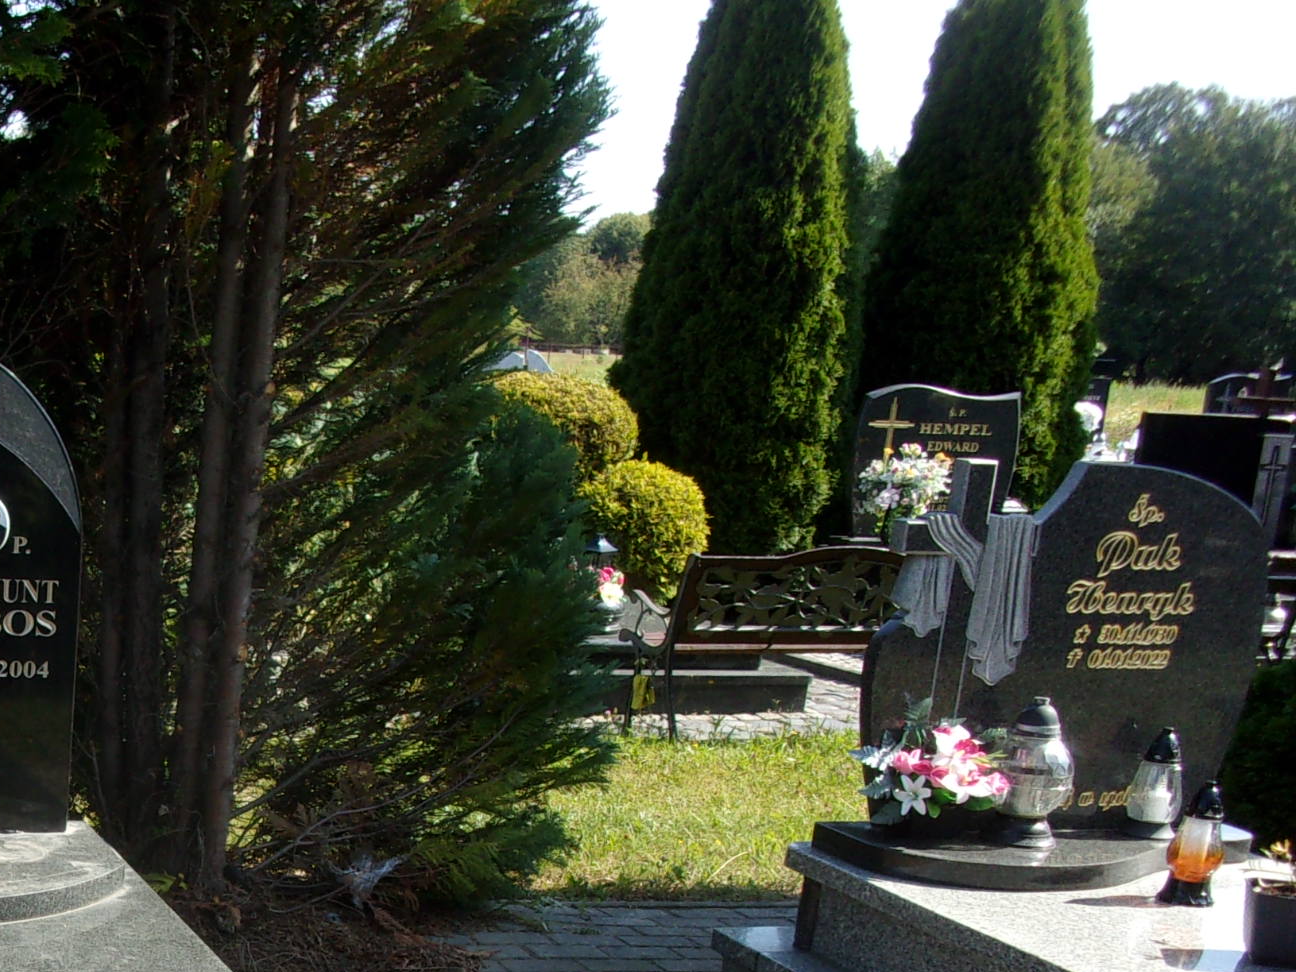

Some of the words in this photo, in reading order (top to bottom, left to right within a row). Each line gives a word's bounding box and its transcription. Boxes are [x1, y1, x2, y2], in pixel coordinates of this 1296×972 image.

[919, 422, 992, 436] HEMPEL
[927, 440, 979, 453] EDWARD
[12, 536, 31, 555] P.
[1066, 579, 1194, 621] Henryk
[1087, 646, 1171, 670] 01.01.2022
